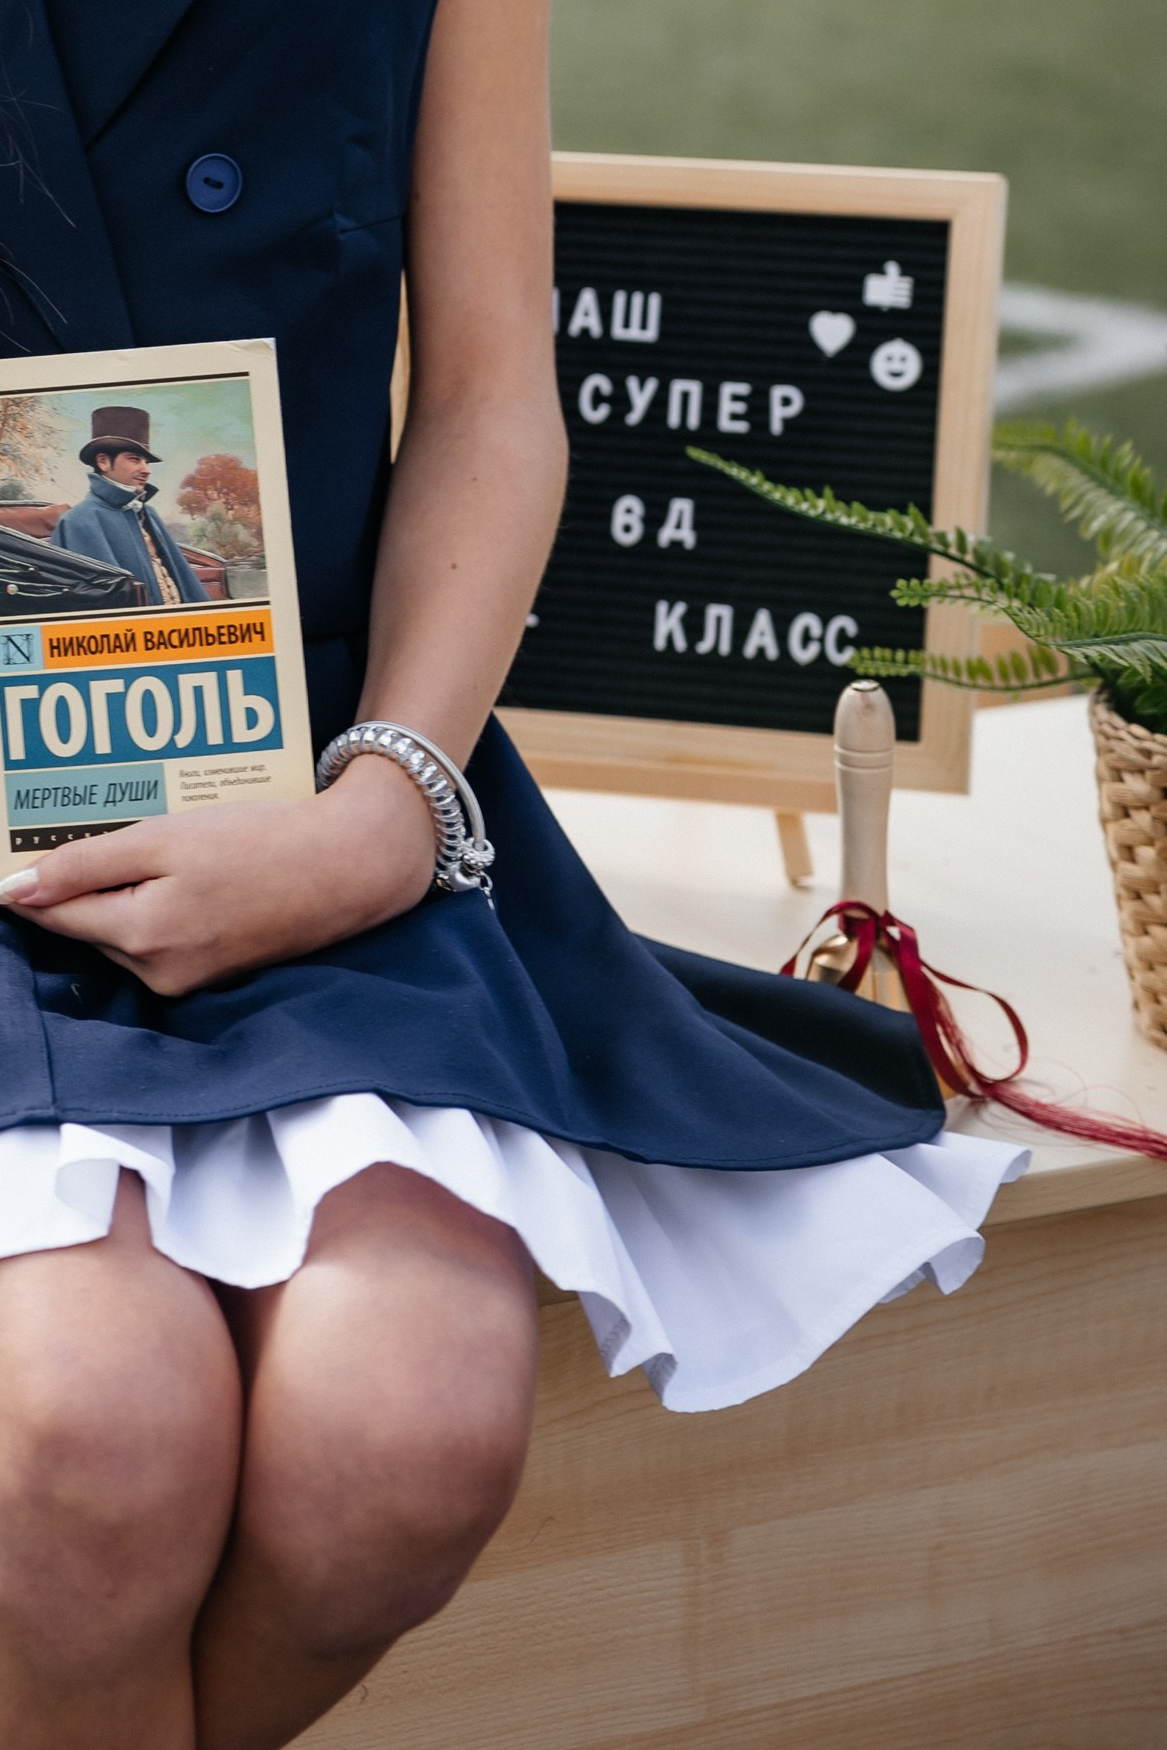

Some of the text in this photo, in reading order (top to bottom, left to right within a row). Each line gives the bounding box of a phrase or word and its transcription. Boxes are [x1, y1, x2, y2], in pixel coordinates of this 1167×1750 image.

[552, 286, 662, 343] АШ
[577, 373, 805, 436] СУПЕР
[49, 622, 266, 658] НИКОЛАЙ ВАСИЛЬЕВИЧ
[653, 599, 859, 667] КЛАСС
[3, 669, 276, 761] ГОГОЛЬ
[13, 780, 159, 810] МЕРТВЫЕ ДУШИ
